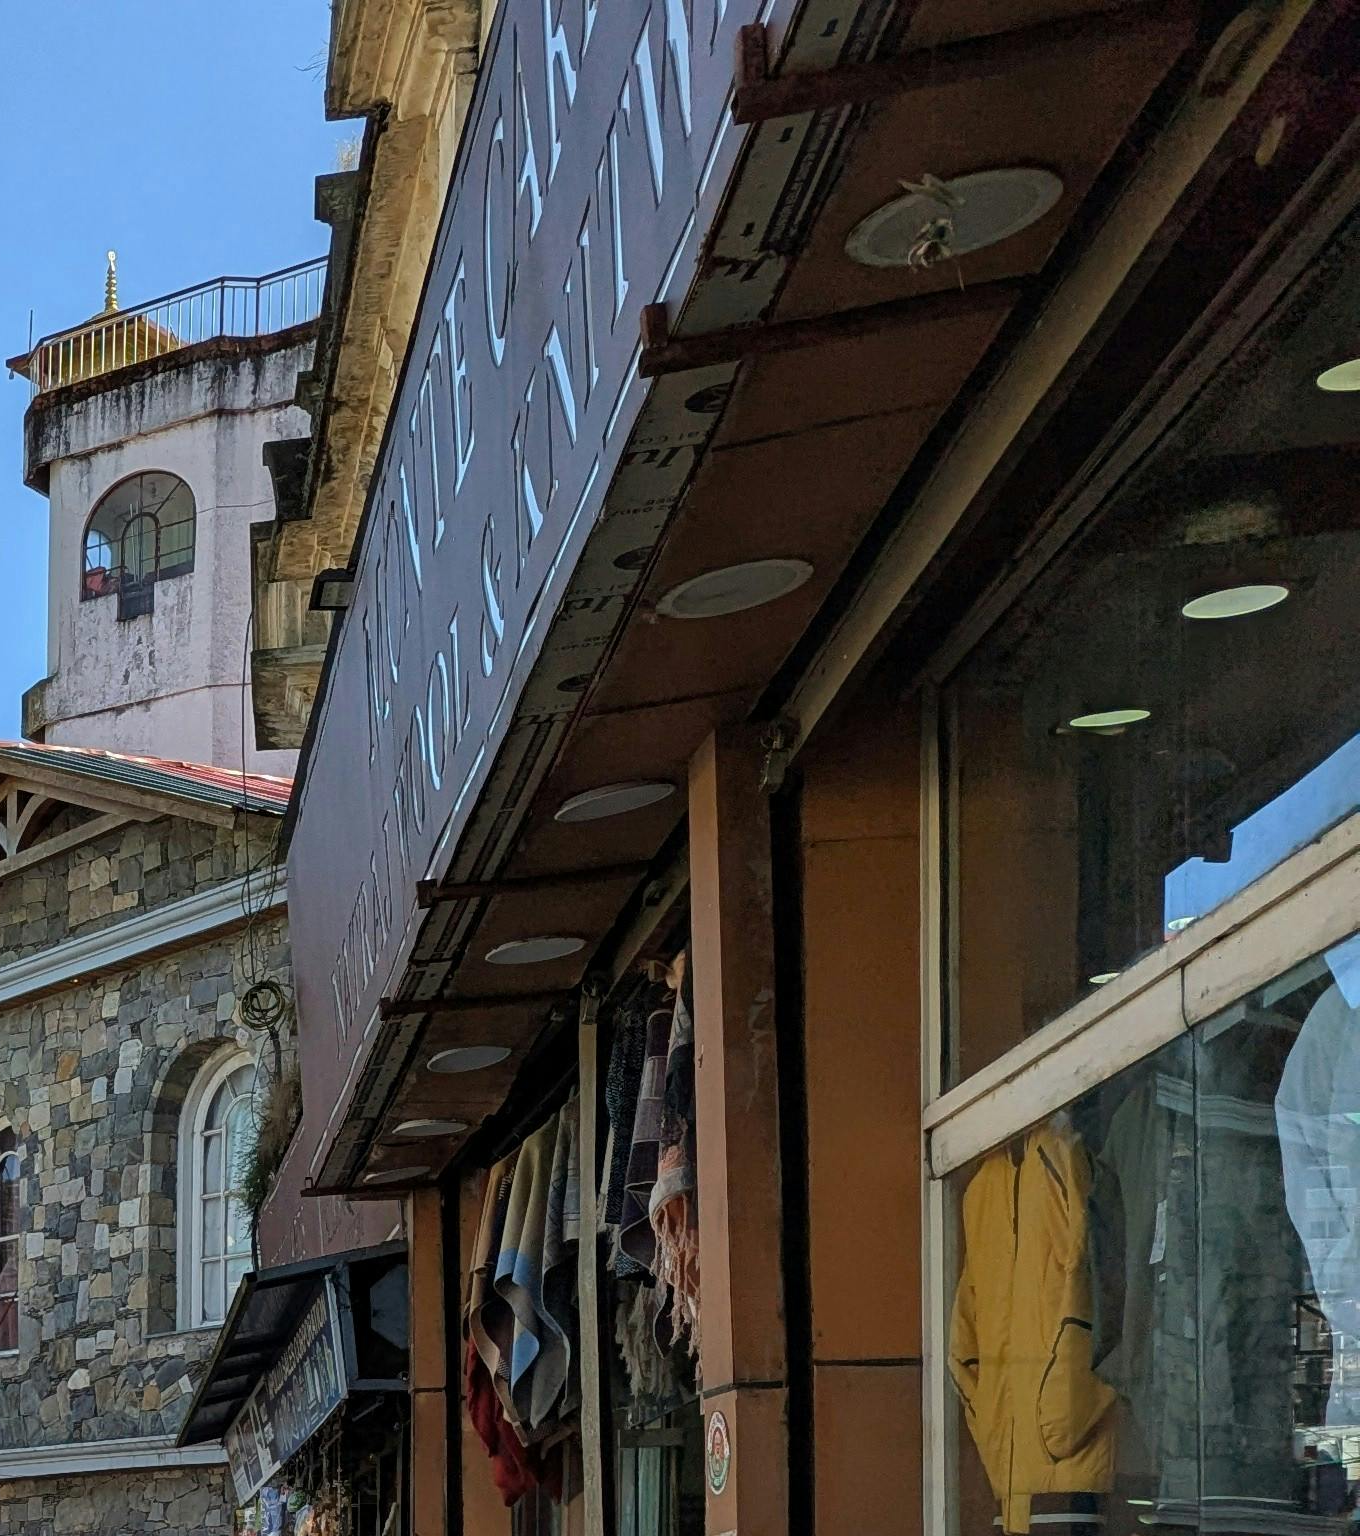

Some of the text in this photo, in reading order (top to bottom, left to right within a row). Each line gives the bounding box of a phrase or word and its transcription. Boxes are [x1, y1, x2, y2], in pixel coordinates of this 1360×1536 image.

[364, 255, 476, 772] MONTE
[332, 810, 393, 1062] NATRAJ
[394, 603, 472, 876] WOOL
[482, 513, 504, 678] &
